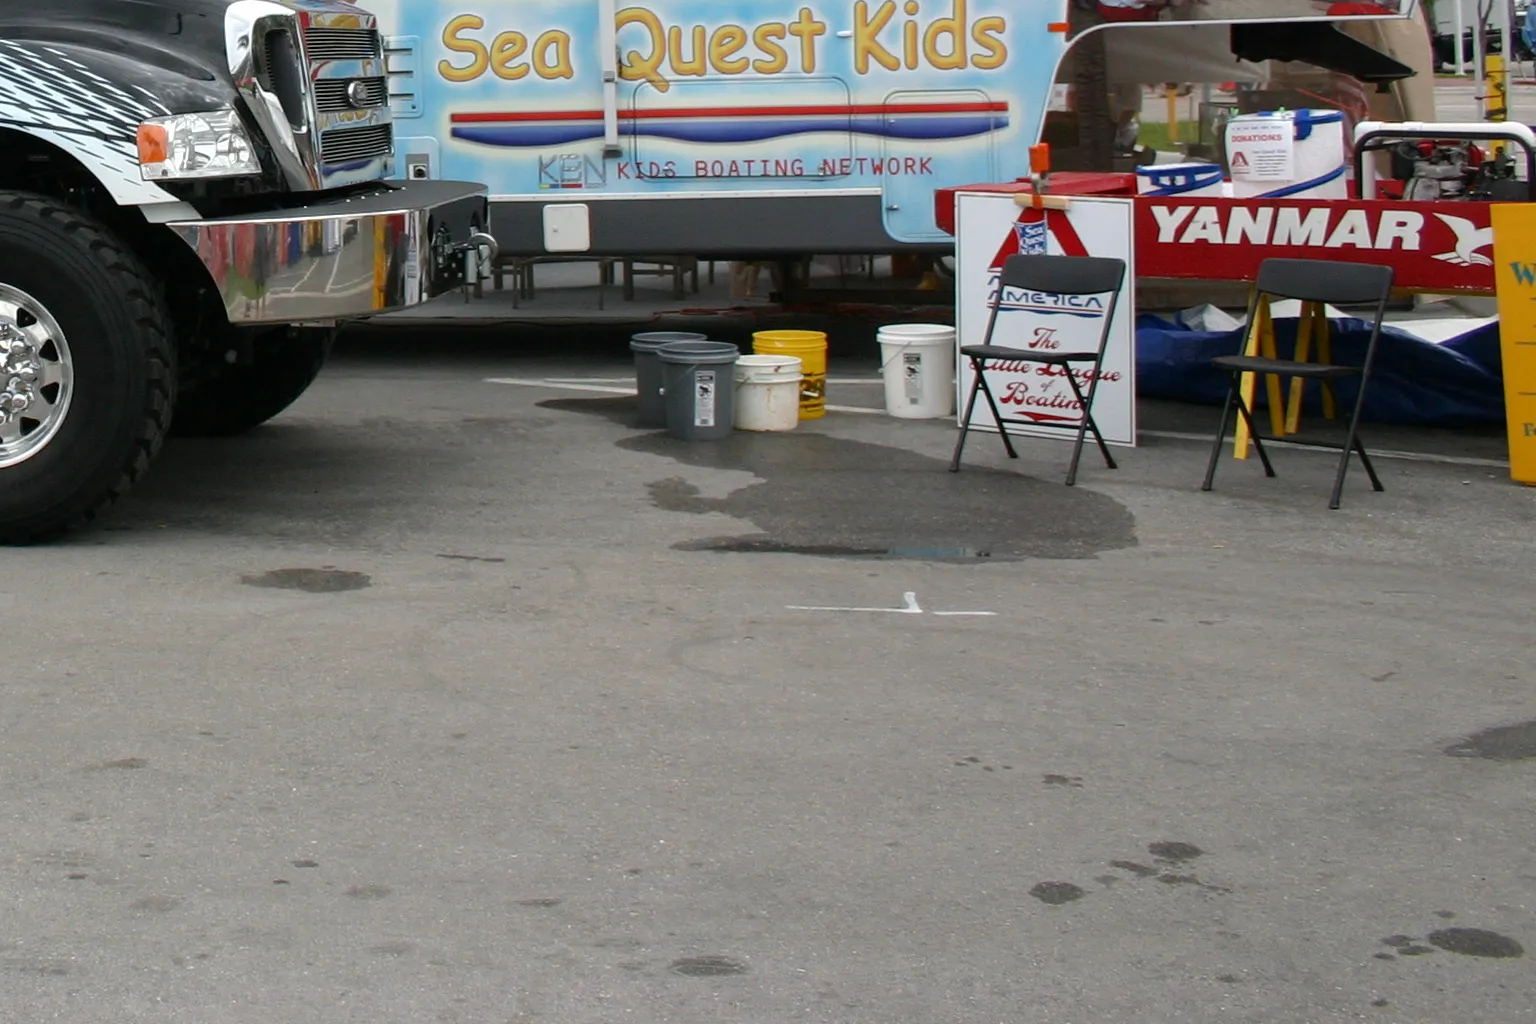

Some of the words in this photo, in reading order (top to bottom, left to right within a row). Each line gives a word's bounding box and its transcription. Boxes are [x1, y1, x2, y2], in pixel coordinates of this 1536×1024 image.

[438, 13, 574, 82] Sea
[614, 6, 826, 93] Quest
[1231, 133, 1282, 143] DONATIONS
[617, 160, 677, 180] KIDS
[695, 158, 805, 179] BOATING
[821, 156, 934, 177] NETWORK
[1024, 225, 1043, 237] Sea
[1150, 205, 1425, 251] YANMAR
[988, 290, 1104, 308] AMERICA
[1028, 327, 1060, 350] The
[1040, 379, 1056, 393] of
